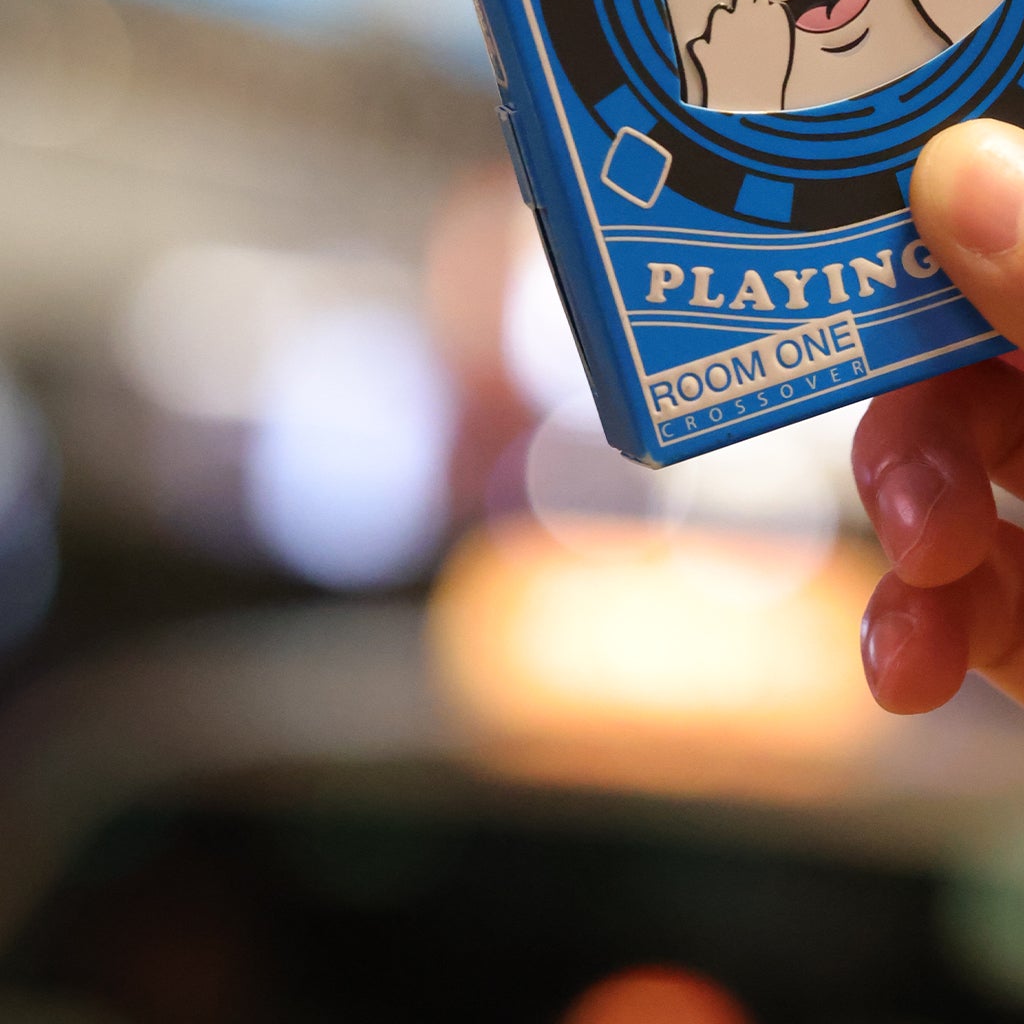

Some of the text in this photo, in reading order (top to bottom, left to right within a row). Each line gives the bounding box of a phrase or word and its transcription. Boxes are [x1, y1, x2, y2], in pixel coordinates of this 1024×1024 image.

[645, 238, 941, 313] PLAYING
[649, 319, 856, 413] ROOM ONE
[660, 359, 865, 439] CROSSOVER
